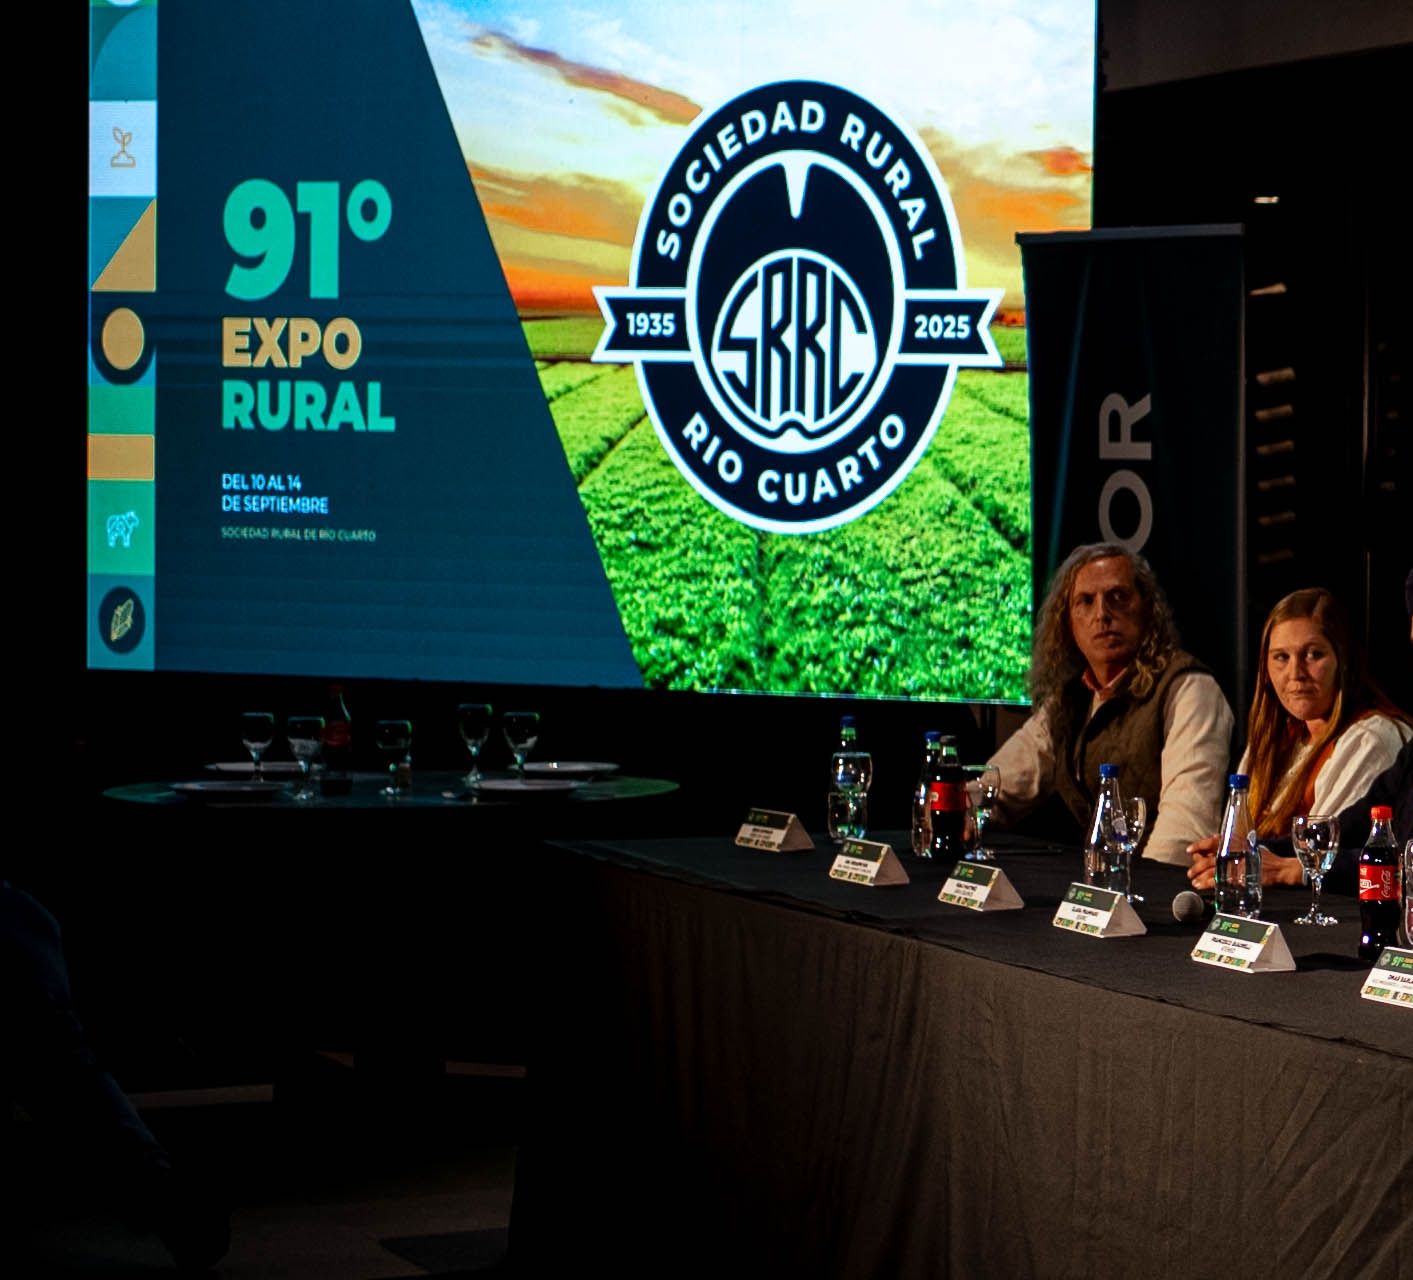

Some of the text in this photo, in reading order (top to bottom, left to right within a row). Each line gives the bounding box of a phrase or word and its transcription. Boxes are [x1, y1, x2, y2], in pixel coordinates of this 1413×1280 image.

[656, 99, 938, 261] SOCIEDAD RURAL
[626, 312, 676, 336] 1935
[914, 314, 971, 340] 2025
[221, 316, 362, 371] EXPO
[221, 380, 396, 433] RURAL
[682, 412, 906, 504] RIO CUARTO
[221, 473, 303, 491] DEL 10 AL 14
[221, 494, 330, 514] DE SEPTIEMBRE
[221, 526, 269, 539] SOCIEDAD
[303, 528, 317, 541] DE
[337, 528, 377, 542] CUARTO
